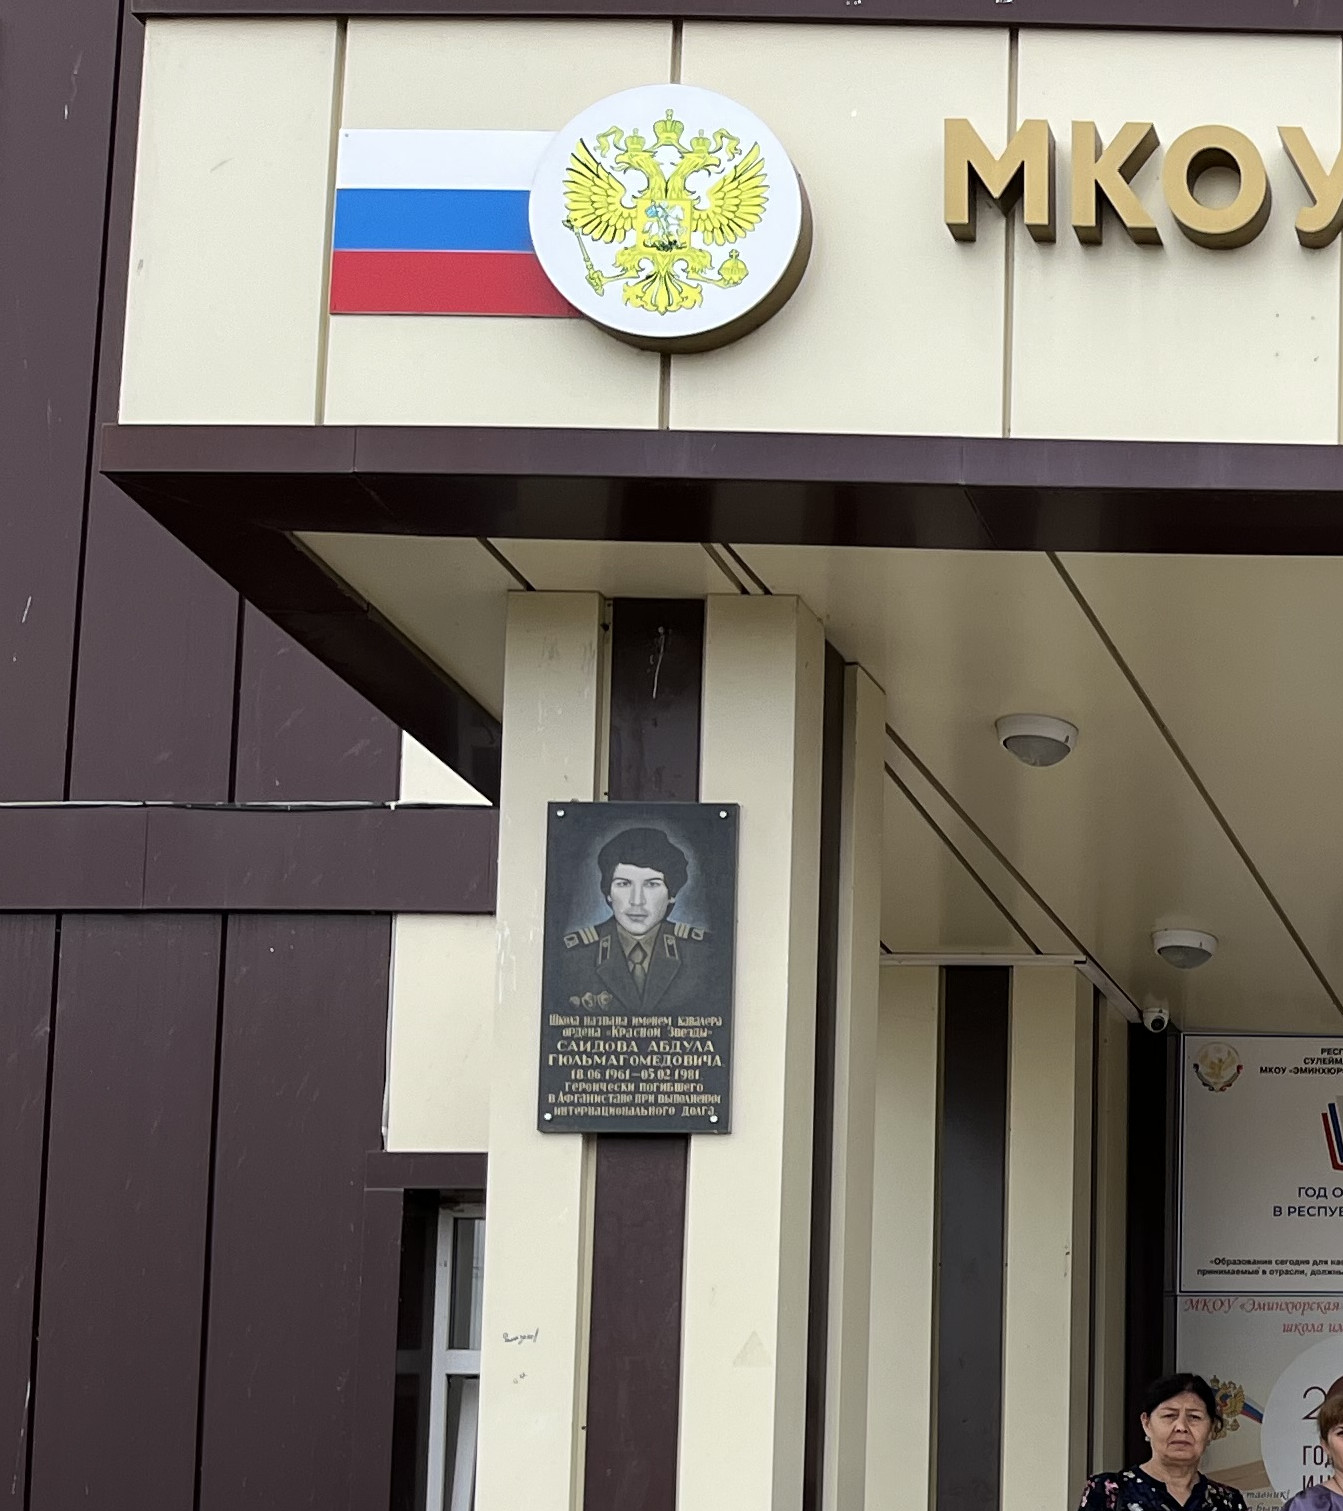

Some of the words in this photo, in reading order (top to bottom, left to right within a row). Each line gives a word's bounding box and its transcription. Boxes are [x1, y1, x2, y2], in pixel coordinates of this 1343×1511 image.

[549, 1014, 579, 1026] Школа
[584, 1016, 628, 1026] названа
[632, 1016, 672, 1026] именем
[678, 1016, 722, 1027] кавалера
[562, 1026, 600, 1038] ордена
[556, 1040, 638, 1053] САИДОВА
[647, 1040, 714, 1053] АБДУЛА
[548, 1054, 722, 1068] ГЮЛЬМАГОМЕДОВИЧА
[1260, 1066, 1286, 1075] МКОУ
[548, 1094, 555, 1103] в
[557, 1090, 632, 1104] Афганистане
[635, 1094, 655, 1104] при
[554, 1106, 675, 1117] интернационального
[1298, 1187, 1328, 1200] ГОД
[1273, 1206, 1282, 1217] В
[1184, 1298, 1237, 1314] МКОУ
[1282, 1322, 1323, 1336] школа
